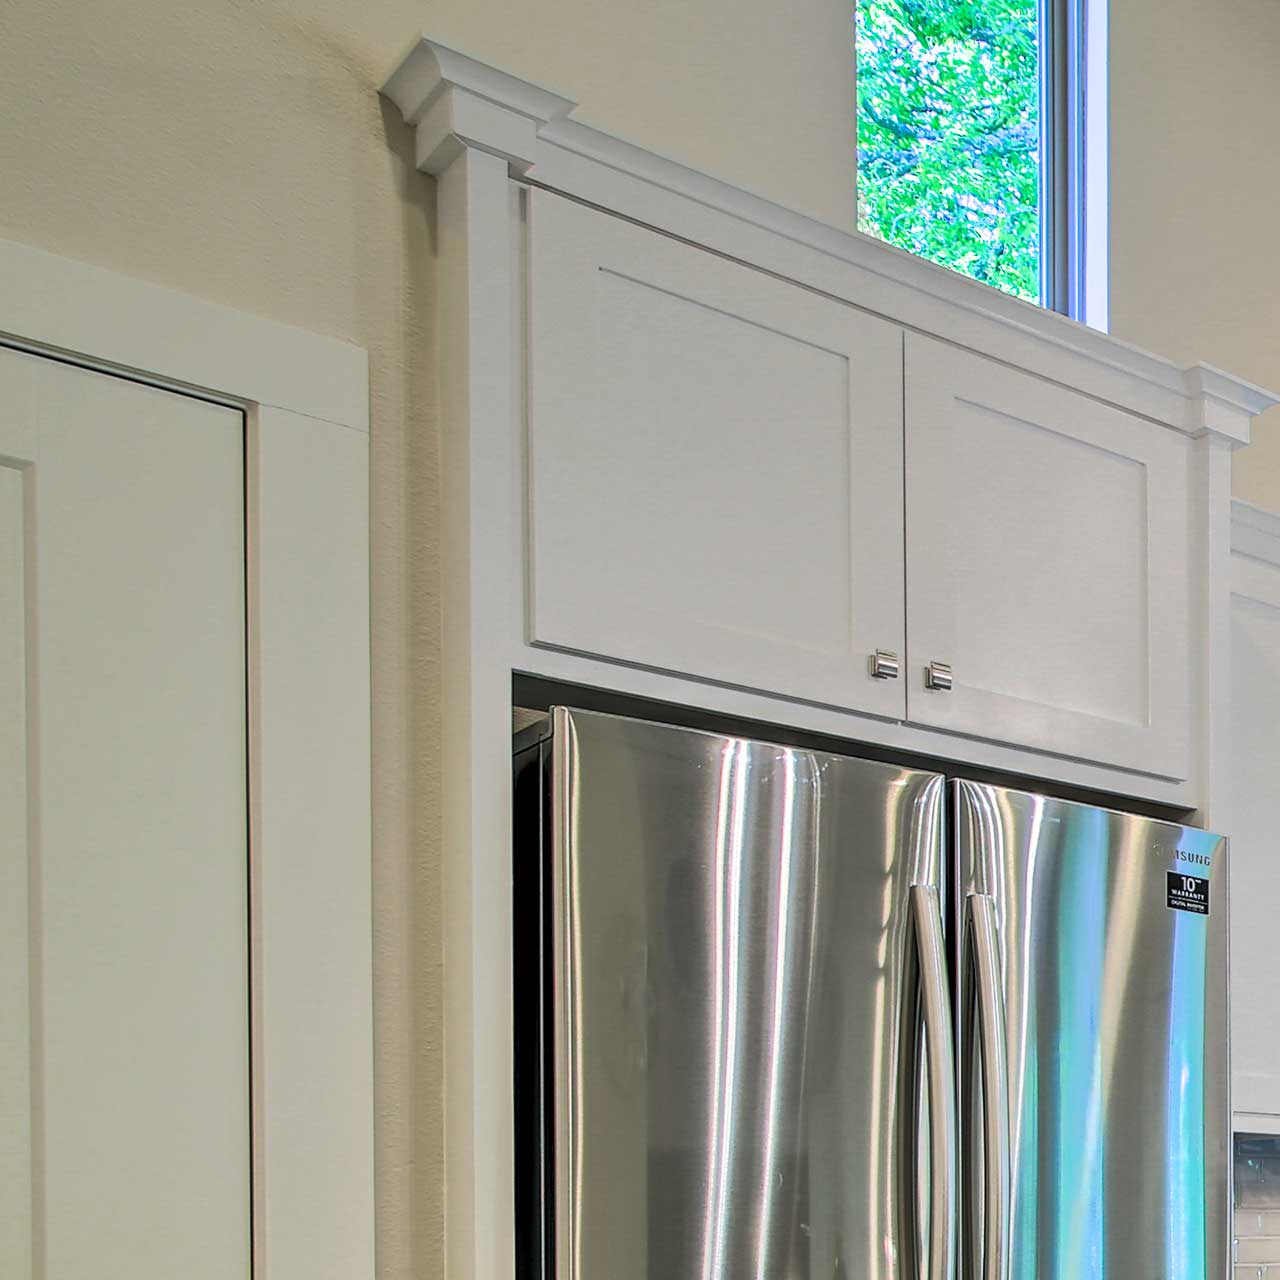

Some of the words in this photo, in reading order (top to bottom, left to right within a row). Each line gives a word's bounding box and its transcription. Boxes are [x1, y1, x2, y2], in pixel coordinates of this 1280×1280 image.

[1153, 844, 1211, 866] SSUNG
[1181, 877, 1196, 892] 10
[1171, 889, 1205, 901] WARRANTY
